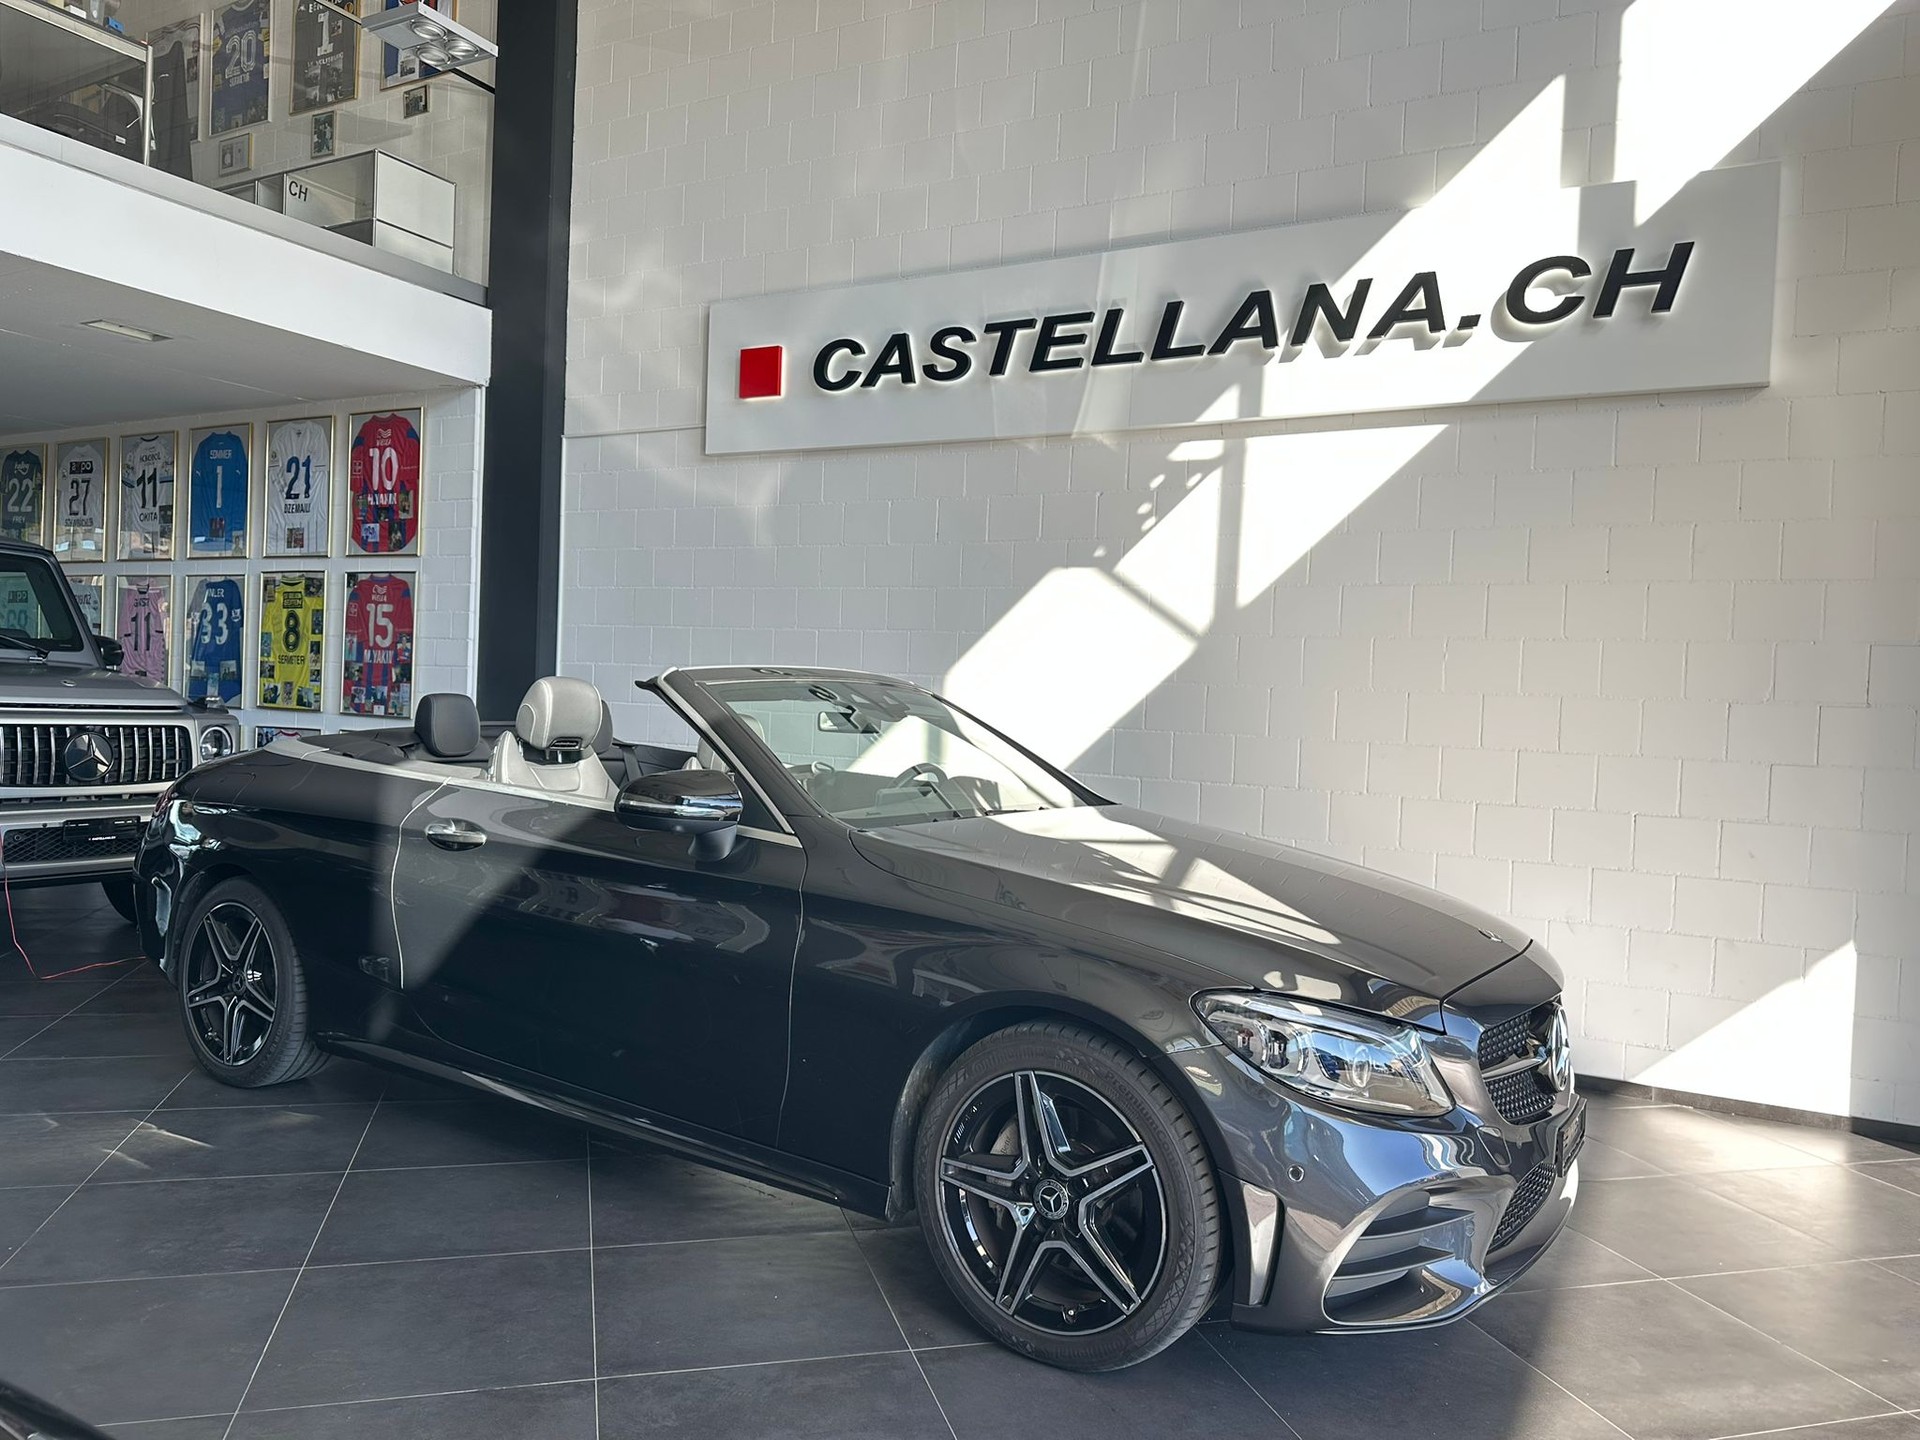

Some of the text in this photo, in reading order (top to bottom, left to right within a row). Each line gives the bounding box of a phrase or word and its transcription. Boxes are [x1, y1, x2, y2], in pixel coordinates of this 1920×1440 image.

[225, 30, 256, 79] 20
[317, 10, 333, 56] 1
[289, 180, 308, 202] CH
[813, 241, 1695, 391] CASTELLANA.CH
[136, 467, 157, 508] 11
[216, 466, 223, 509] 1
[285, 455, 311, 499] 21
[369, 446, 399, 491] 10
[7, 478, 33, 512] 22
[69, 478, 91, 516] 27
[131, 612, 151, 652] 11
[201, 601, 229, 645] 33
[283, 609, 300, 653] 8
[366, 603, 394, 648] 15
